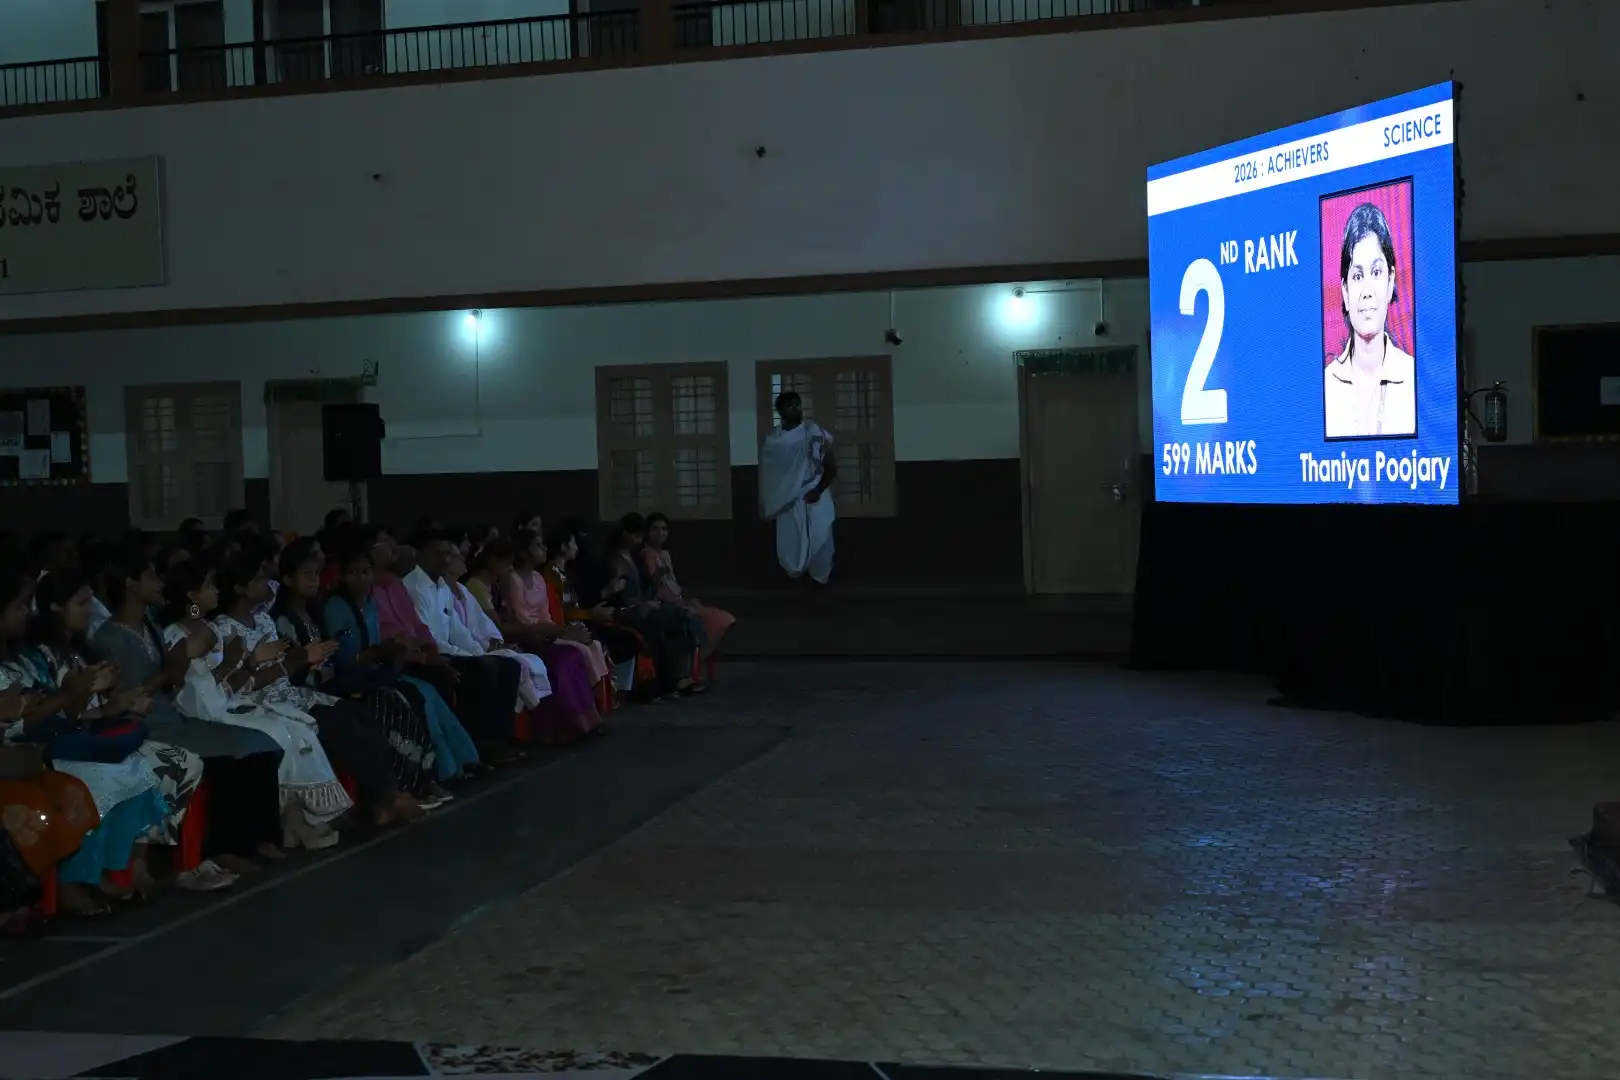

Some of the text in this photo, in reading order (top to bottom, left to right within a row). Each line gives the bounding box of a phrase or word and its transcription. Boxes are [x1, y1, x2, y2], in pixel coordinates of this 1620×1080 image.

[1383, 114, 1442, 147] SCIENCE
[1234, 161, 1258, 183] 2026
[1267, 141, 1329, 174] ACHIEVERS
[78, 173, 138, 222] ಶಾಲೆ
[1179, 230, 1299, 425] 2 ND RANK
[1162, 440, 1257, 475] 599 MARKS
[1300, 450, 1451, 489] Thaniya Poojary
